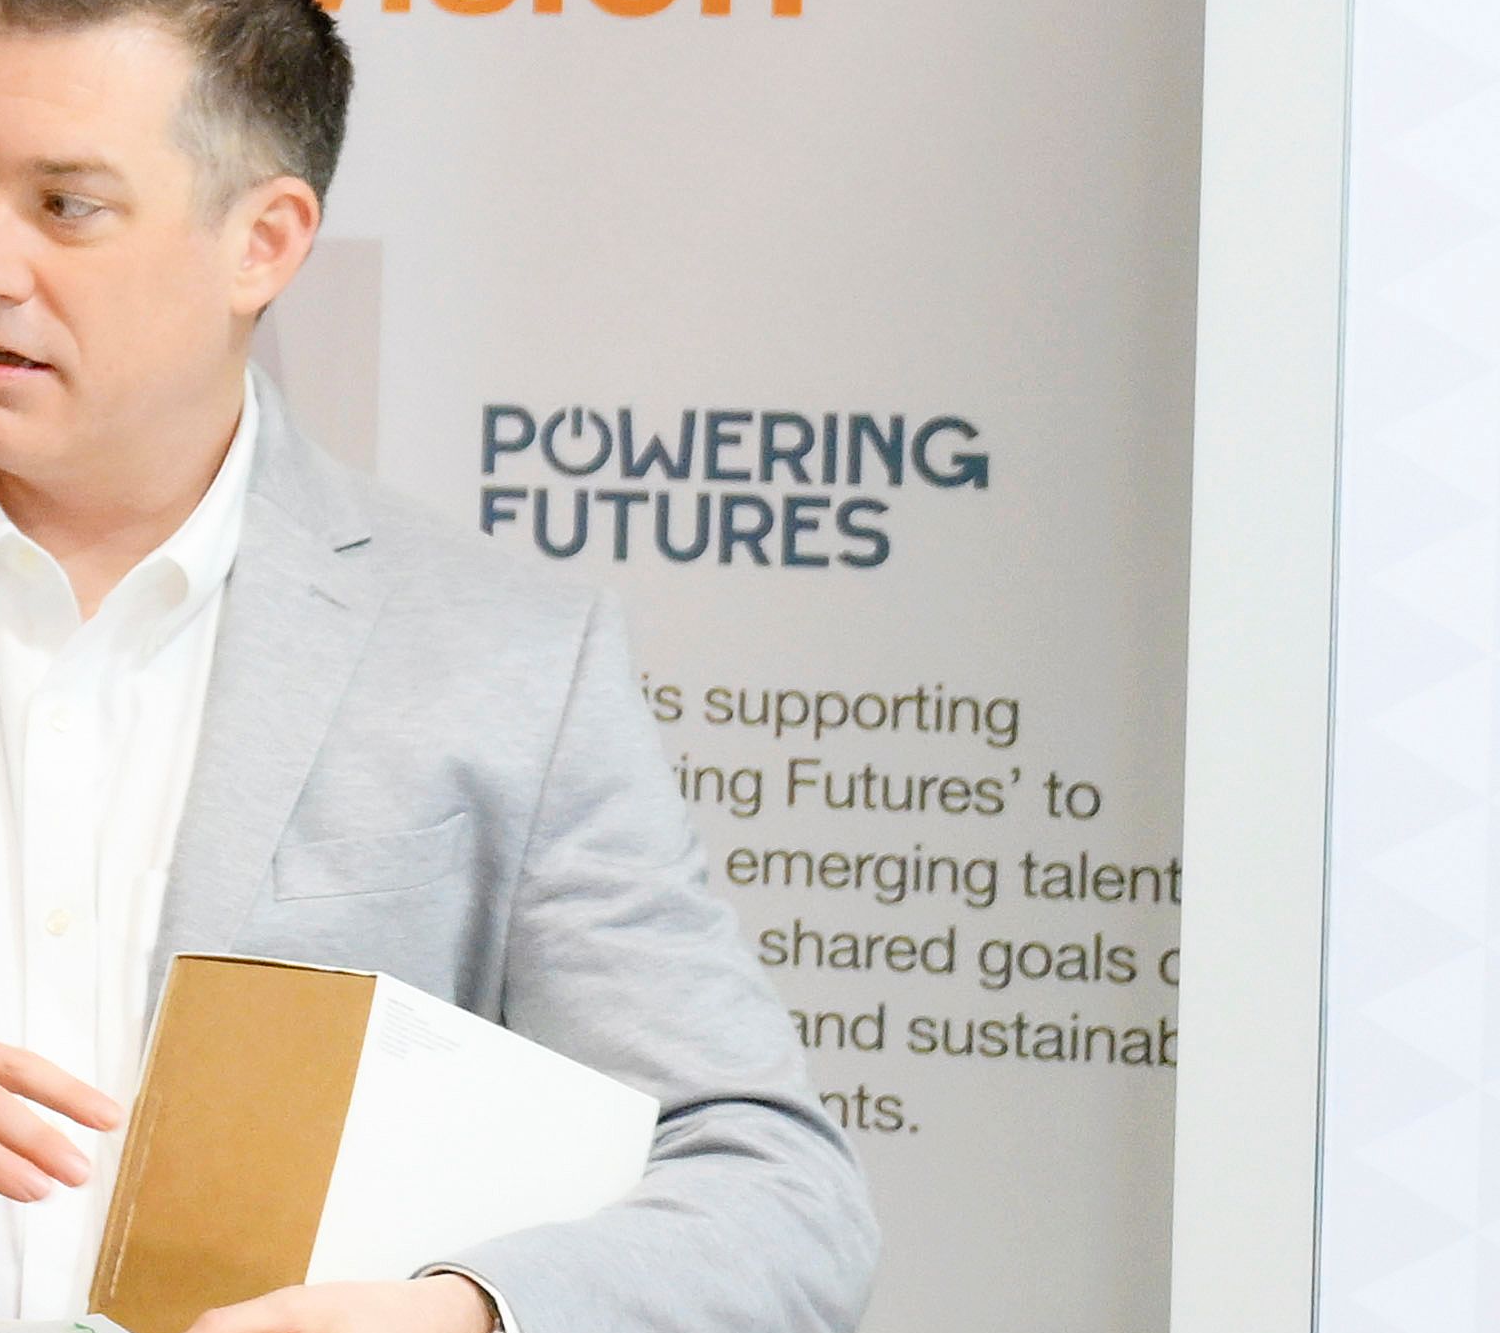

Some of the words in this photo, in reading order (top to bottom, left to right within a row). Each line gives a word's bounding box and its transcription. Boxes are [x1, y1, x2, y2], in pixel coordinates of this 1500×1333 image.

[481, 403, 991, 491] POWERING
[480, 487, 892, 570] FUTURES
[704, 681, 1021, 751] supporting
[672, 751, 763, 818] ing
[1044, 771, 1103, 822] to
[726, 843, 999, 910] emerging
[759, 918, 957, 975] shared
[978, 931, 1140, 991] goals
